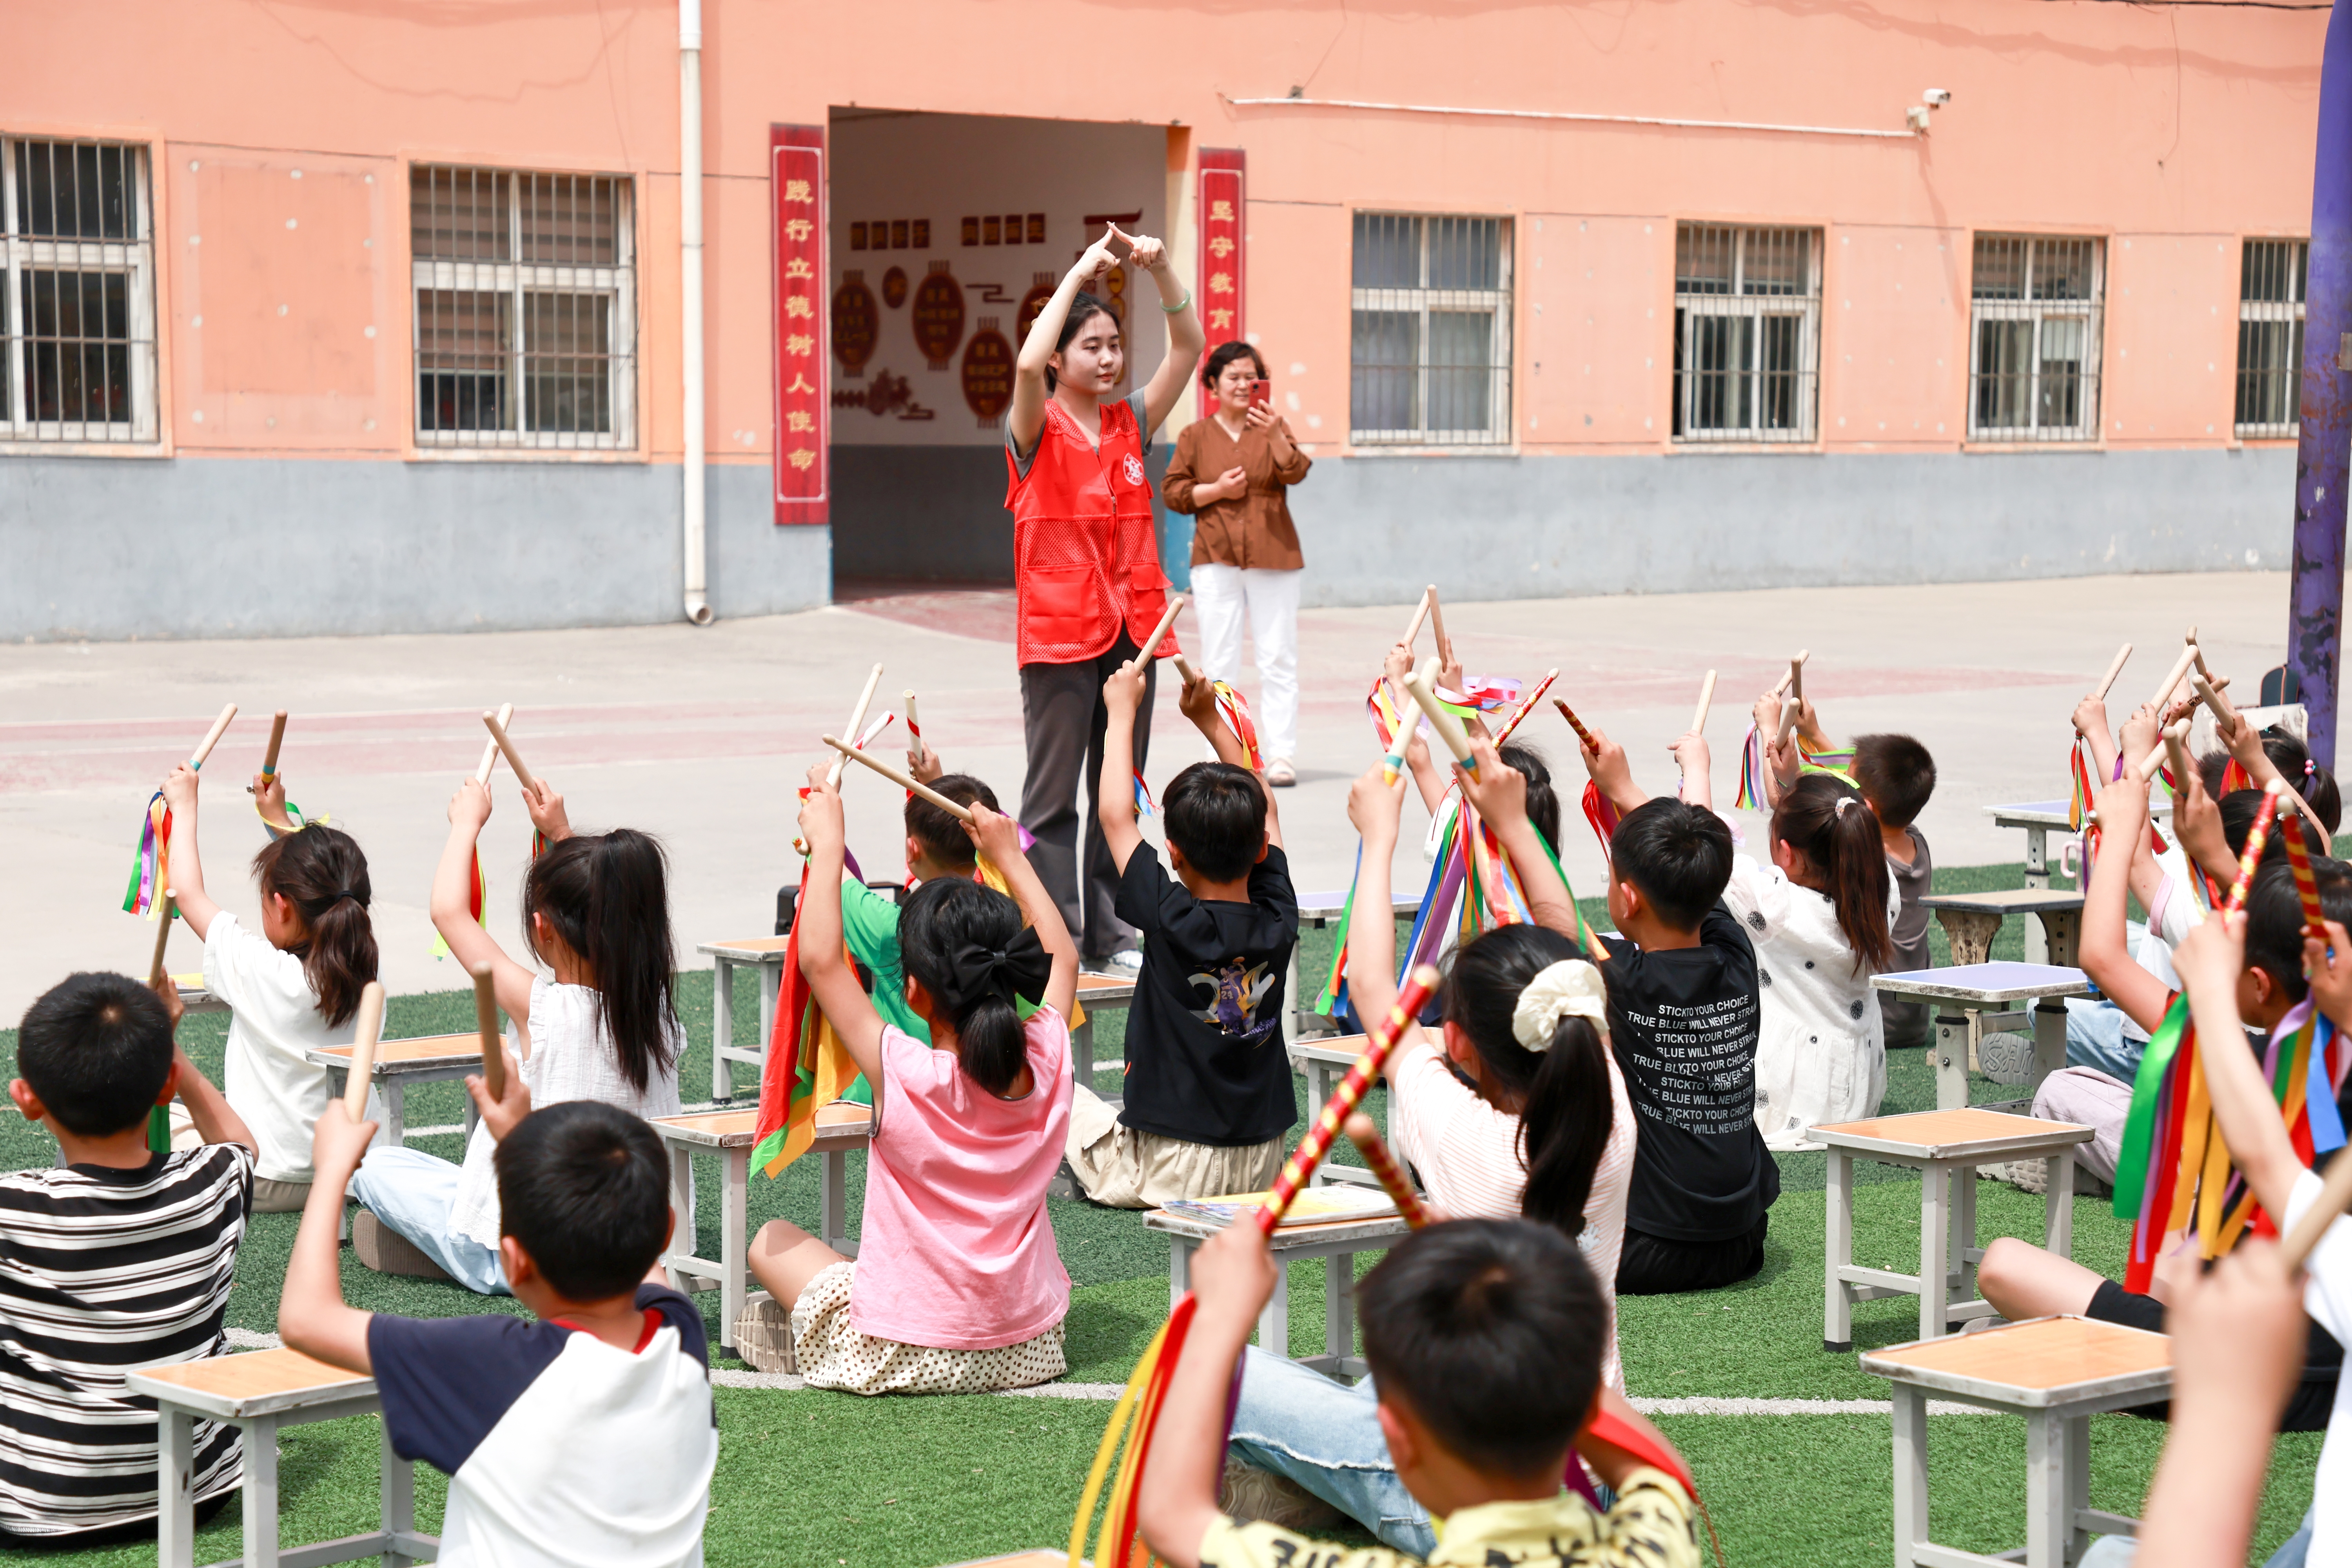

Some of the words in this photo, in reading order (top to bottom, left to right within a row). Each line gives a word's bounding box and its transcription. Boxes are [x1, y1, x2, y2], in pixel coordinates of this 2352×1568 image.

[785, 179, 817, 471] 践行立德树人使命
[1221, 991, 1234, 999] 24
[1659, 1005, 1693, 1017] STICKTO
[1695, 1004, 1715, 1015] YOUR
[1717, 995, 1748, 1011] CHOICE
[1628, 1011, 1656, 1027] TRUE
[1659, 1019, 1687, 1029] BLUE
[1689, 1019, 1709, 1030] WILL
[1708, 1013, 1735, 1027] NEVER
[1655, 1033, 1696, 1043] STICKTO
[1699, 1031, 1722, 1043] YOUR
[1724, 1022, 1748, 1038] CHOICE
[1657, 1047, 1685, 1058] BLUE
[1688, 1047, 1710, 1058] WILL
[1712, 1041, 1738, 1055] NEVER
[1633, 1053, 1662, 1070] TRUE
[1714, 1069, 1743, 1082] NEVER
[1701, 1060, 1725, 1071] YOUR
[1727, 1051, 1749, 1067] CHOICE
[1661, 1077, 1705, 1091] STICKTO
[1708, 1082, 1731, 1091] YOUR
[1662, 1091, 1690, 1104] BLUE
[1693, 1095, 1715, 1105] WILL
[1718, 1091, 1742, 1105] NEVER
[1636, 1100, 1663, 1120] TRUE
[1693, 1124, 1716, 1134] WILL
[1719, 1120, 1743, 1134] NEVER
[1666, 1107, 1702, 1119] TICKTO
[1704, 1110, 1728, 1120] YOUR
[1730, 1101, 1750, 1118] CHOICE
